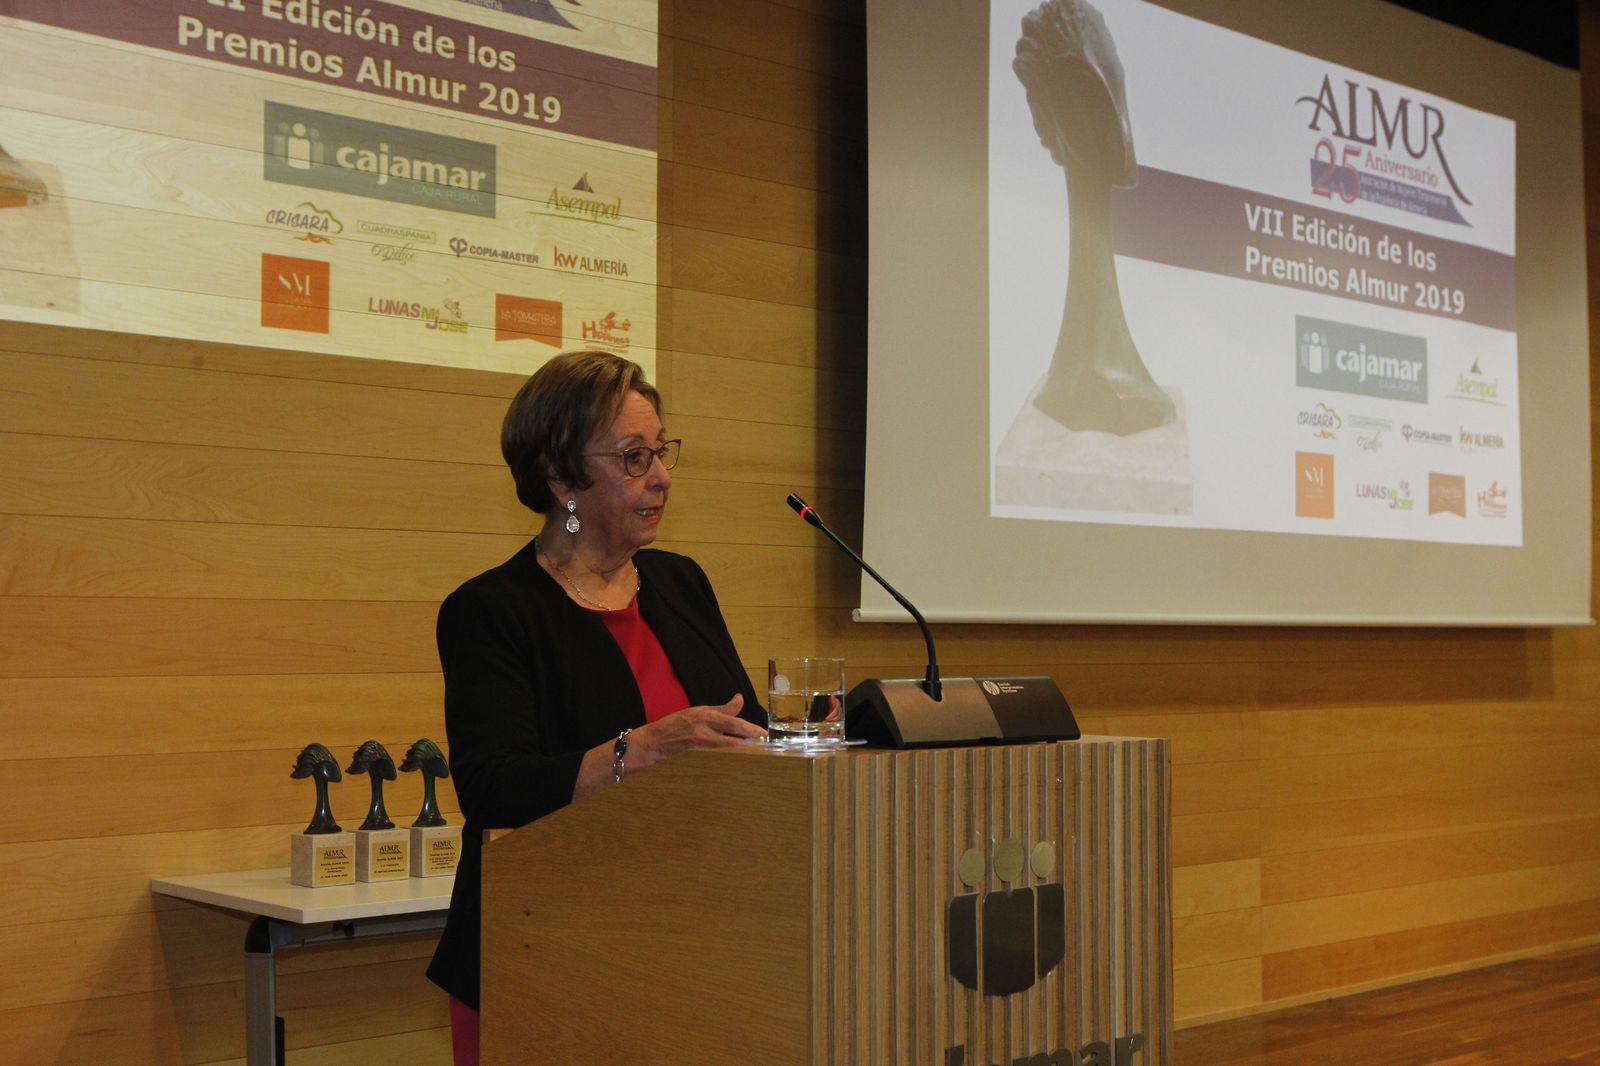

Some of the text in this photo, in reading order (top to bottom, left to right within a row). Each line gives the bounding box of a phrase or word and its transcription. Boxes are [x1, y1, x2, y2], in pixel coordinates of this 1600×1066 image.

[262, 0, 517, 72] Edición de los
[178, 15, 562, 124] Premios Almur 2019
[336, 143, 487, 190] cajamar
[1295, 73, 1473, 206] ALMUR
[1311, 137, 1362, 204] 25
[1364, 150, 1439, 188] Aniversario
[546, 186, 623, 222] Asempal
[469, 244, 540, 264] COPIA-MASTER
[1244, 203, 1437, 272] VII Edición de los
[580, 256, 629, 278] ALMERÍA
[1245, 245, 1465, 315] Premios Almur 2019
[368, 297, 422, 318] LUNAS
[1335, 343, 1423, 383] cajamar
